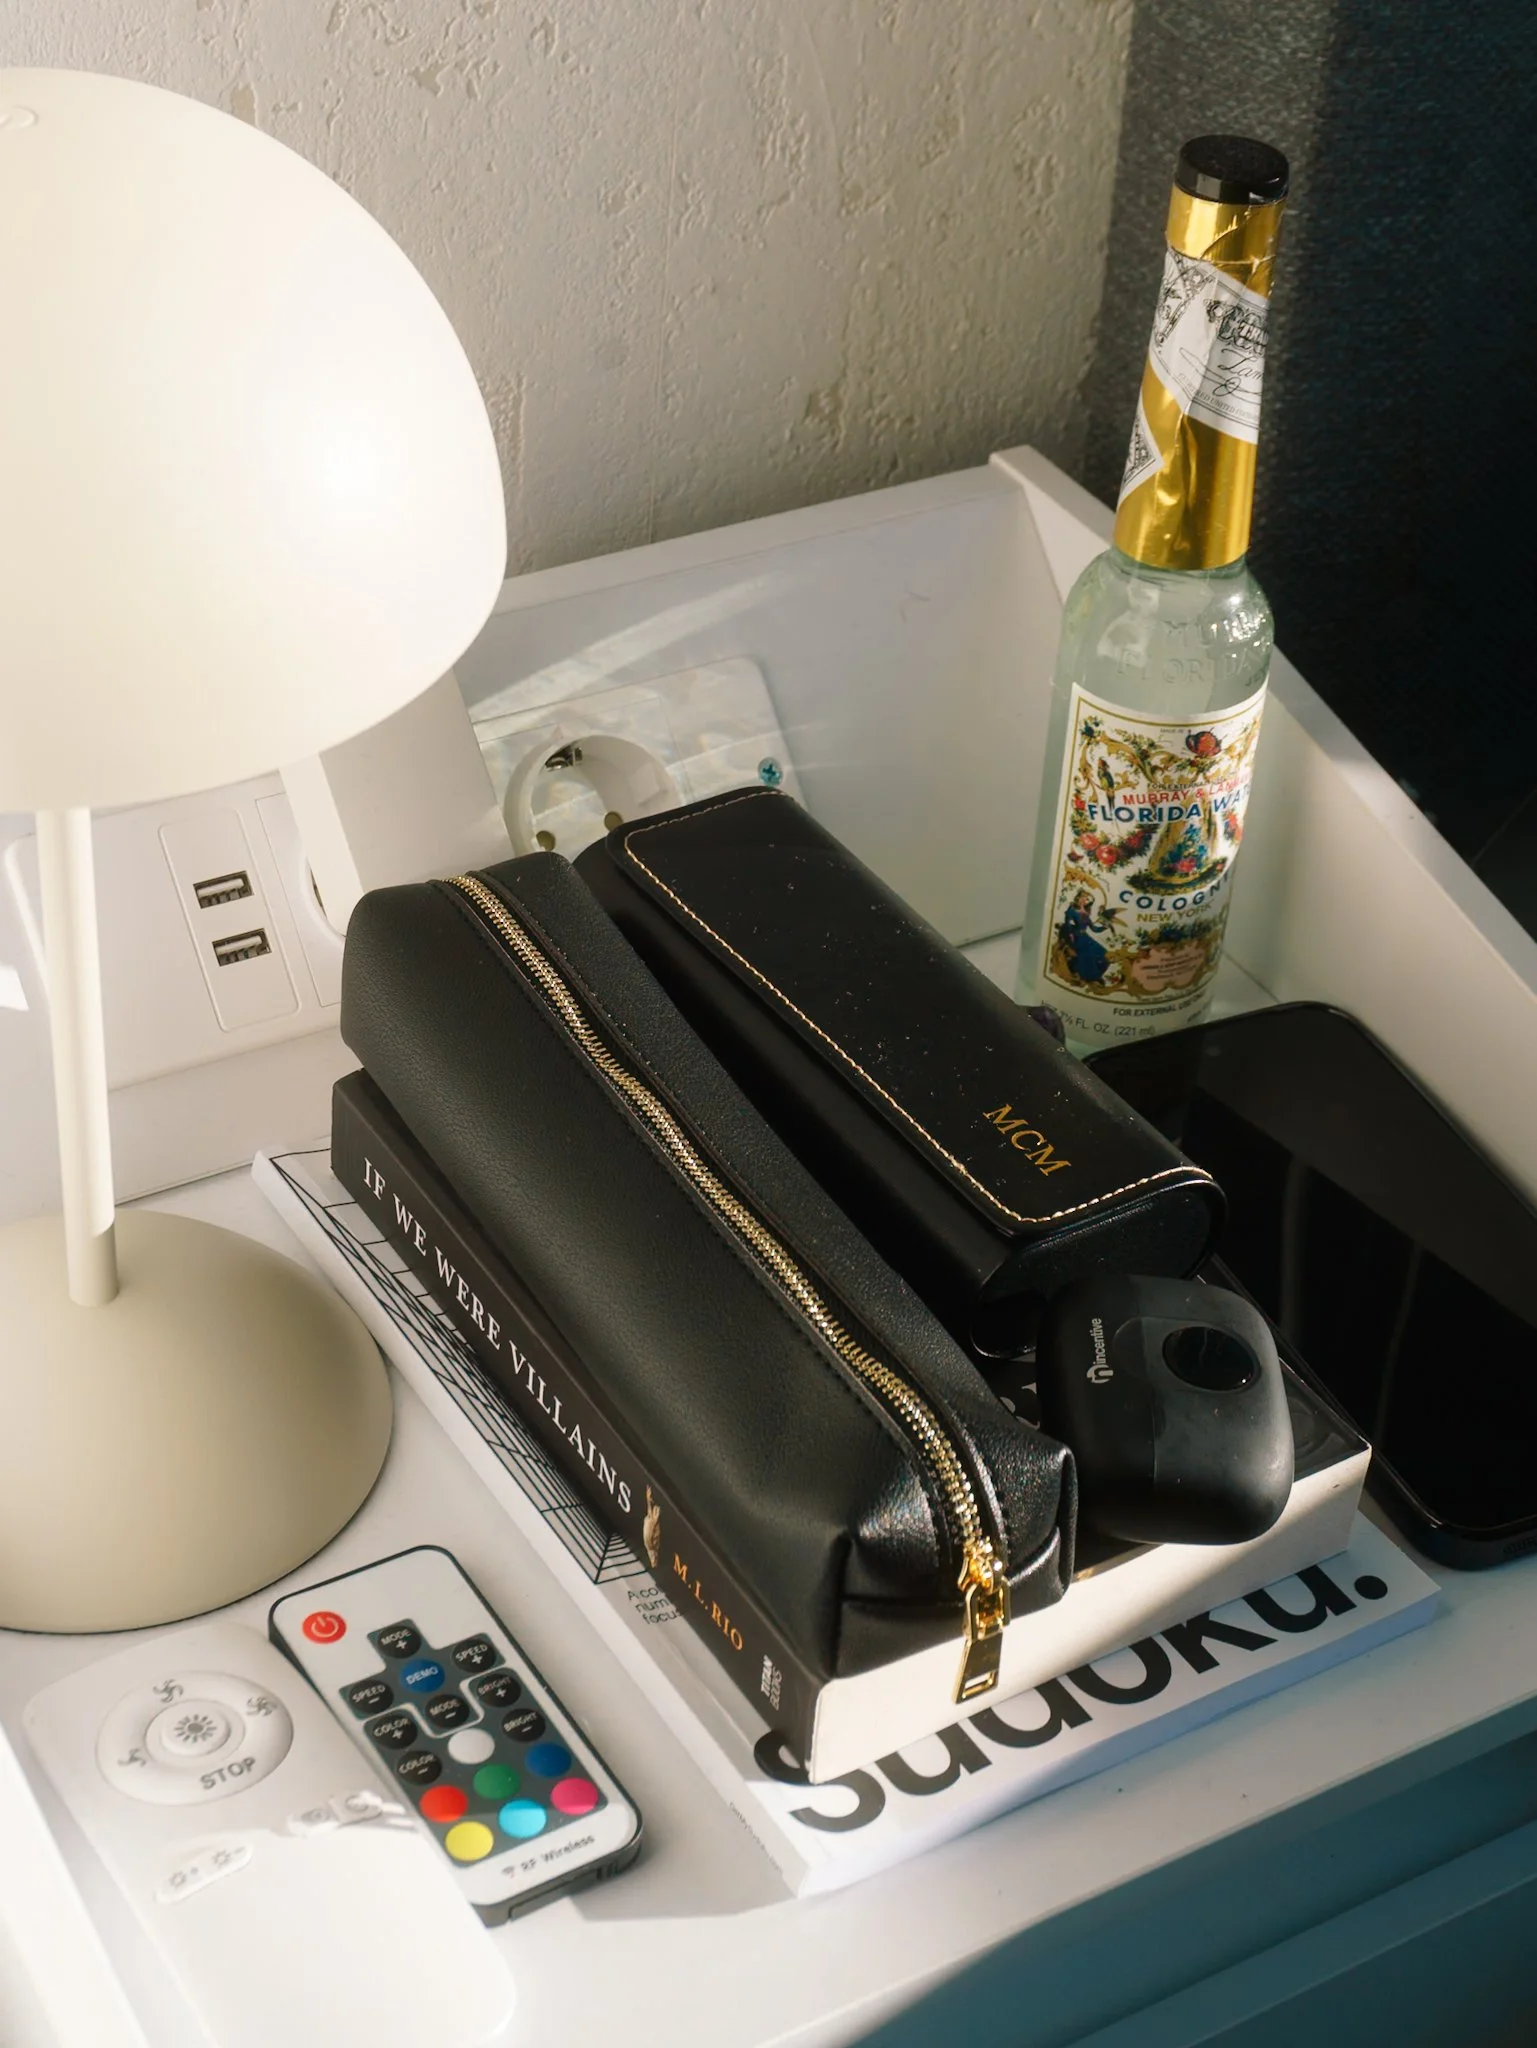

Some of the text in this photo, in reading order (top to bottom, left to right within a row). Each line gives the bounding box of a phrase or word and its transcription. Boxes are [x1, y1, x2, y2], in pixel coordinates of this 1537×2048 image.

[1123, 790, 1190, 805] MURRAY
[1195, 787, 1205, 799] &
[1087, 803, 1202, 823] FLORIDA
[1136, 902, 1212, 923] NEW YORK
[1113, 1007, 1132, 1017] FOR
[1134, 1003, 1177, 1017] EXTERNAL
[1114, 1026, 1137, 1037] (221
[1139, 1025, 1156, 1037] ml)
[982, 1103, 1072, 1177] MCM
[363, 1156, 632, 1514] IF WE WERE VILLAINS
[1089, 1317, 1107, 1365] incentive
[627, 1587, 659, 1601] A co
[635, 1598, 670, 1613] num
[381, 1628, 412, 1646] MODE
[455, 1643, 489, 1662] SPEED
[405, 1666, 439, 1685] DEMO
[351, 1684, 386, 1702] SPEED
[478, 1676, 512, 1696] BRIGHT
[429, 1699, 460, 1716] MODE
[374, 1717, 409, 1737] COLOR
[503, 1711, 538, 1733] BRIGHT
[200, 1756, 256, 1790] STOP
[399, 1753, 435, 1774] COLOR
[520, 1835, 596, 1872] RF Wireless
